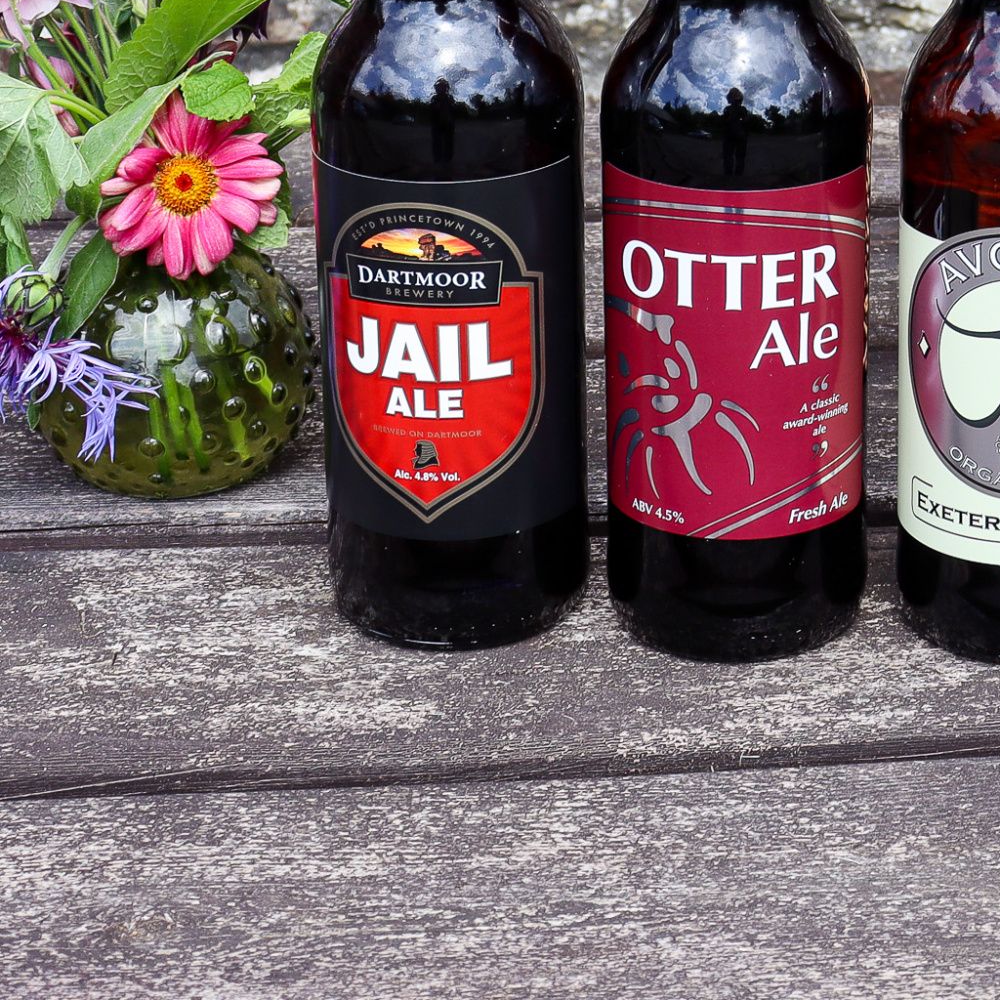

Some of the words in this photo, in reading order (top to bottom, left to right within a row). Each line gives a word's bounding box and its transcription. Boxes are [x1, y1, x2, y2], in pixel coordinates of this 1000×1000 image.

[380, 214, 465, 232] PRINCETOWN
[469, 228, 497, 249] 1994
[357, 265, 487, 289] DARTMOOR
[622, 239, 839, 311] OTTER
[386, 287, 454, 299] BREWERY
[346, 315, 513, 383] JAIL
[749, 312, 839, 370] Ale
[386, 386, 464, 419] ALE
[783, 402, 849, 430] award-winning
[800, 403, 808, 413] A
[811, 393, 841, 411] classic
[409, 430, 424, 438] ON
[427, 430, 482, 438] DARTMOOR
[812, 425, 827, 436] ale
[394, 469, 413, 480] Alc.
[414, 472, 439, 481] 4.8%
[441, 472, 461, 481] Vol.
[631, 497, 654, 516] ABV
[655, 507, 685, 525] 4.5%
[788, 504, 827, 524] Fresh
[828, 491, 849, 514] Ale
[917, 490, 1000, 533] EXETER
